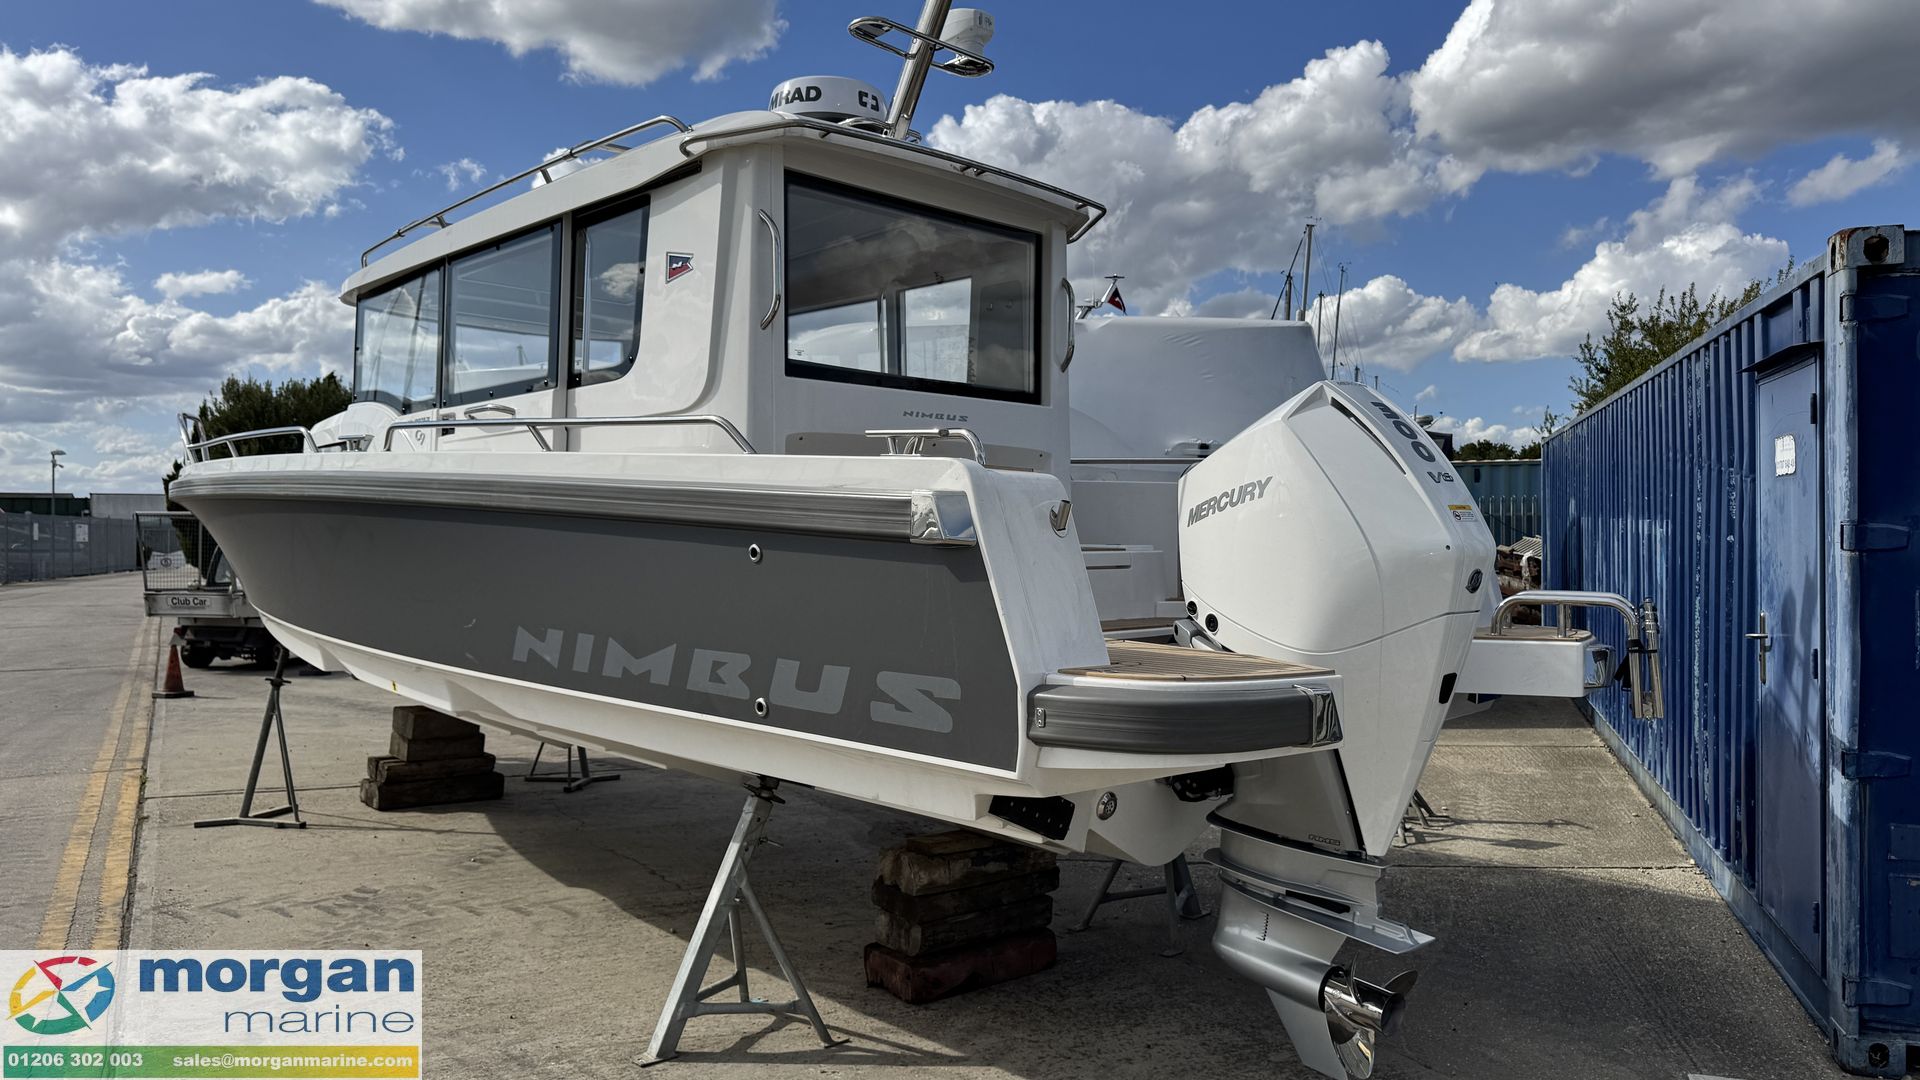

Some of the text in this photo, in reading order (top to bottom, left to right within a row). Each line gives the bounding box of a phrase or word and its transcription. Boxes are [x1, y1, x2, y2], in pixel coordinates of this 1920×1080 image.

[903, 410, 969, 422] NIMBUS
[1187, 475, 1273, 527] MERCURY
[171, 597, 207, 606] Club Car
[512, 626, 962, 733] NIMBUS
